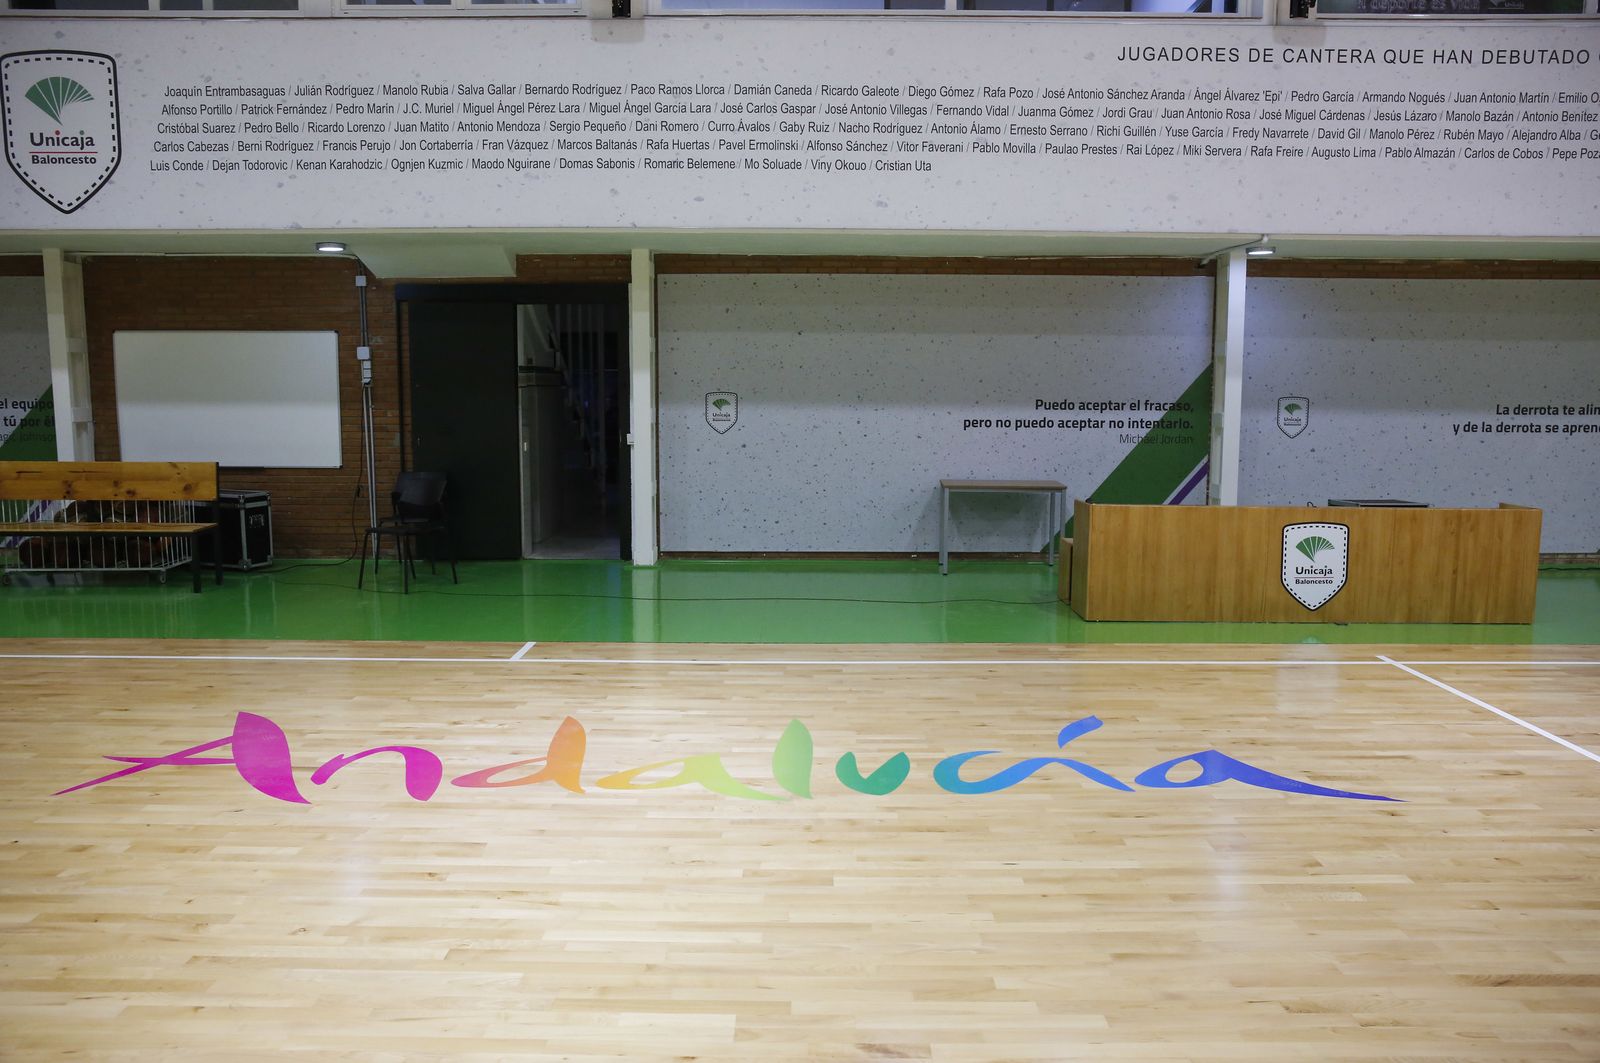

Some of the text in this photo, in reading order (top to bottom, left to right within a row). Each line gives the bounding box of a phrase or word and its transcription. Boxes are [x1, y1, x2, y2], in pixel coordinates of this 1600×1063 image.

[1117, 46, 1240, 63] JUGADORES
[1248, 46, 1274, 63] DE
[1282, 48, 1376, 64] CANTERA
[1383, 48, 1424, 65] QUE
[1432, 49, 1474, 65] HAN
[1481, 49, 1590, 66] DEBUTADO
[458, 83, 1445, 106] Salva Gallar Paco Ramos Llorca Ricardo Galeote Rafa Pozo Armando Nogués
[162, 99, 1513, 122] Alfonso Portillo Patrick Fernández Miguel Ángel Pérez Lara José Carlos Gaspar José Antonio Villegas Fernando Vidal Juanma Gómez Jordi Grau Juan Antonio Rosa Manolo Bazán
[157, 118, 1581, 144] Cristóbal Suarez Pedro Bello Ricardo Lorenzo Juan Matito Antonio Mendoza Sergio Pequeño Dani Romero Curro Ávalos Gaby Ruiz Antonio Álamo Ernesto Serrano Richi Guillén Fredy Navarrete David Gil Manolo Pérez Rubén Mayo Alejandro Alba
[30, 130, 95, 150] Unicaja
[154, 138, 1543, 161] Carlos Cabezas Francis Perujo Fran Vázquez Marcos Baltanás Rafa Huertas Pavel Ermolinski Alfonso Sánchez Pablo Movilla Paulao Prestes Rafa Freire Augusto Lima Pablo Almazán Carlos de Cobos
[32, 154, 97, 165] Baloncesto
[150, 158, 931, 174] Luis Conde Dejan Todorovic Ognjen Kuzmic Maodo Nguirane Domas Sabonis Cristian Uta
[12, 398, 54, 412] equipo
[1035, 399, 1194, 413] Puedo aceptar el fracaso,
[1496, 404, 1509, 415] La
[1513, 404, 1558, 415] derrota
[1563, 406, 1575, 415] te
[4, 416, 16, 426] tú
[963, 417, 1193, 431] pero no puedo aceptar no intentarlo.
[1453, 422, 1600, 436] y de la derrota se apren
[1119, 434, 1158, 444] Michael
[1296, 566, 1332, 576] Unicaja
